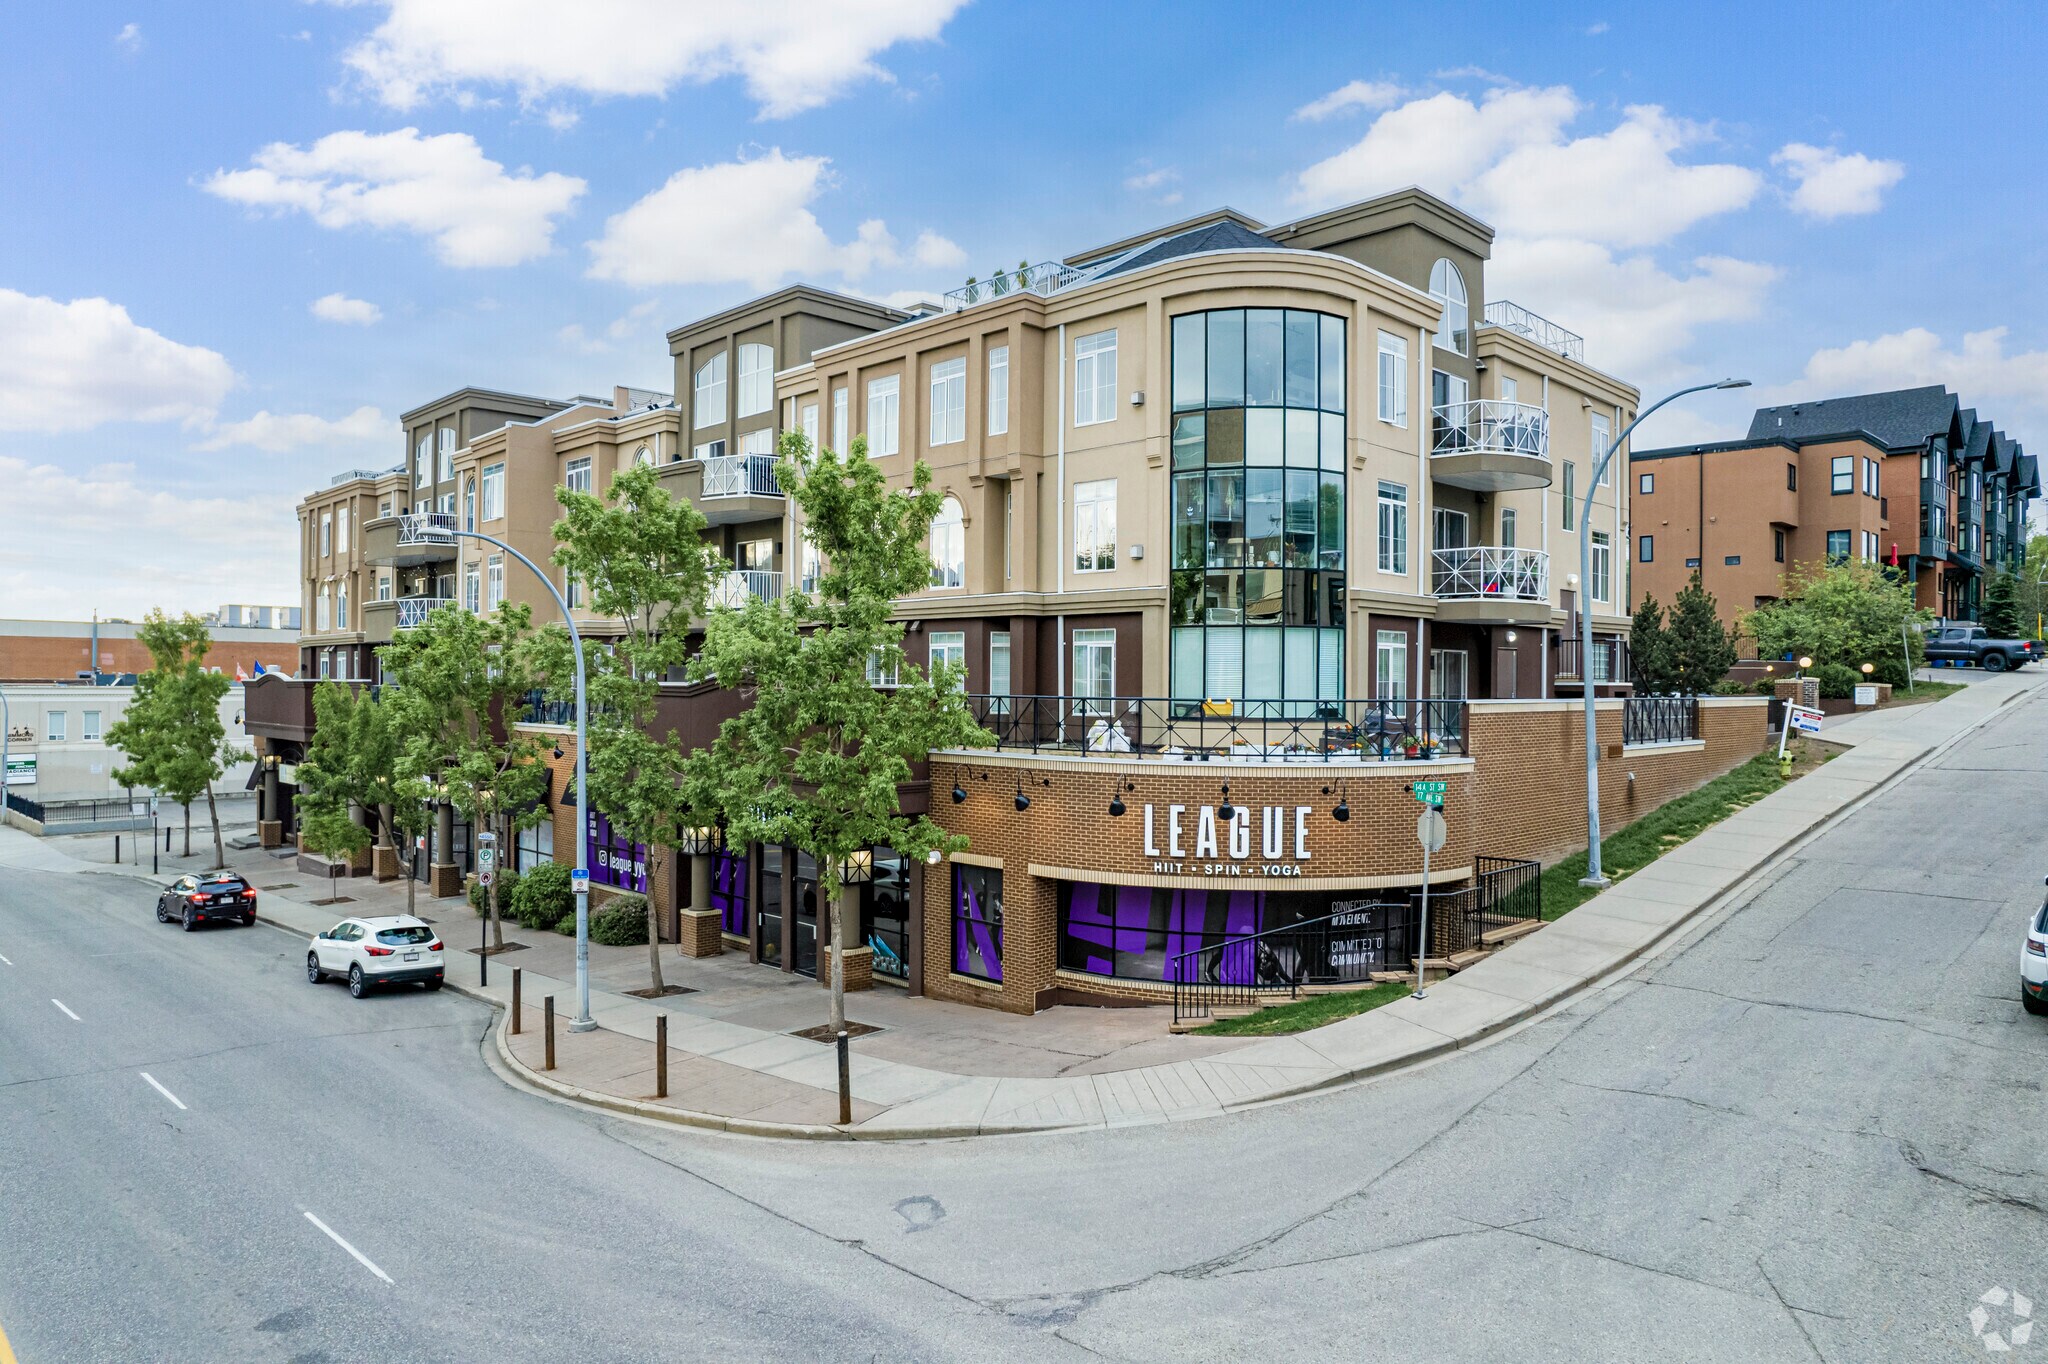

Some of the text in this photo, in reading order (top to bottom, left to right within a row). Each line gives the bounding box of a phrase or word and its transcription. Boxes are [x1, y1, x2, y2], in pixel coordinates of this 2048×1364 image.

[1429, 783, 1435, 791] ST
[1437, 783, 1445, 791] SW
[1144, 803, 1312, 860] LEAGUE
[1154, 861, 1302, 876] HIIT SPIN YOGA
[1331, 900, 1371, 912] CONNECTED
[1331, 938, 1372, 953] COMMTED
